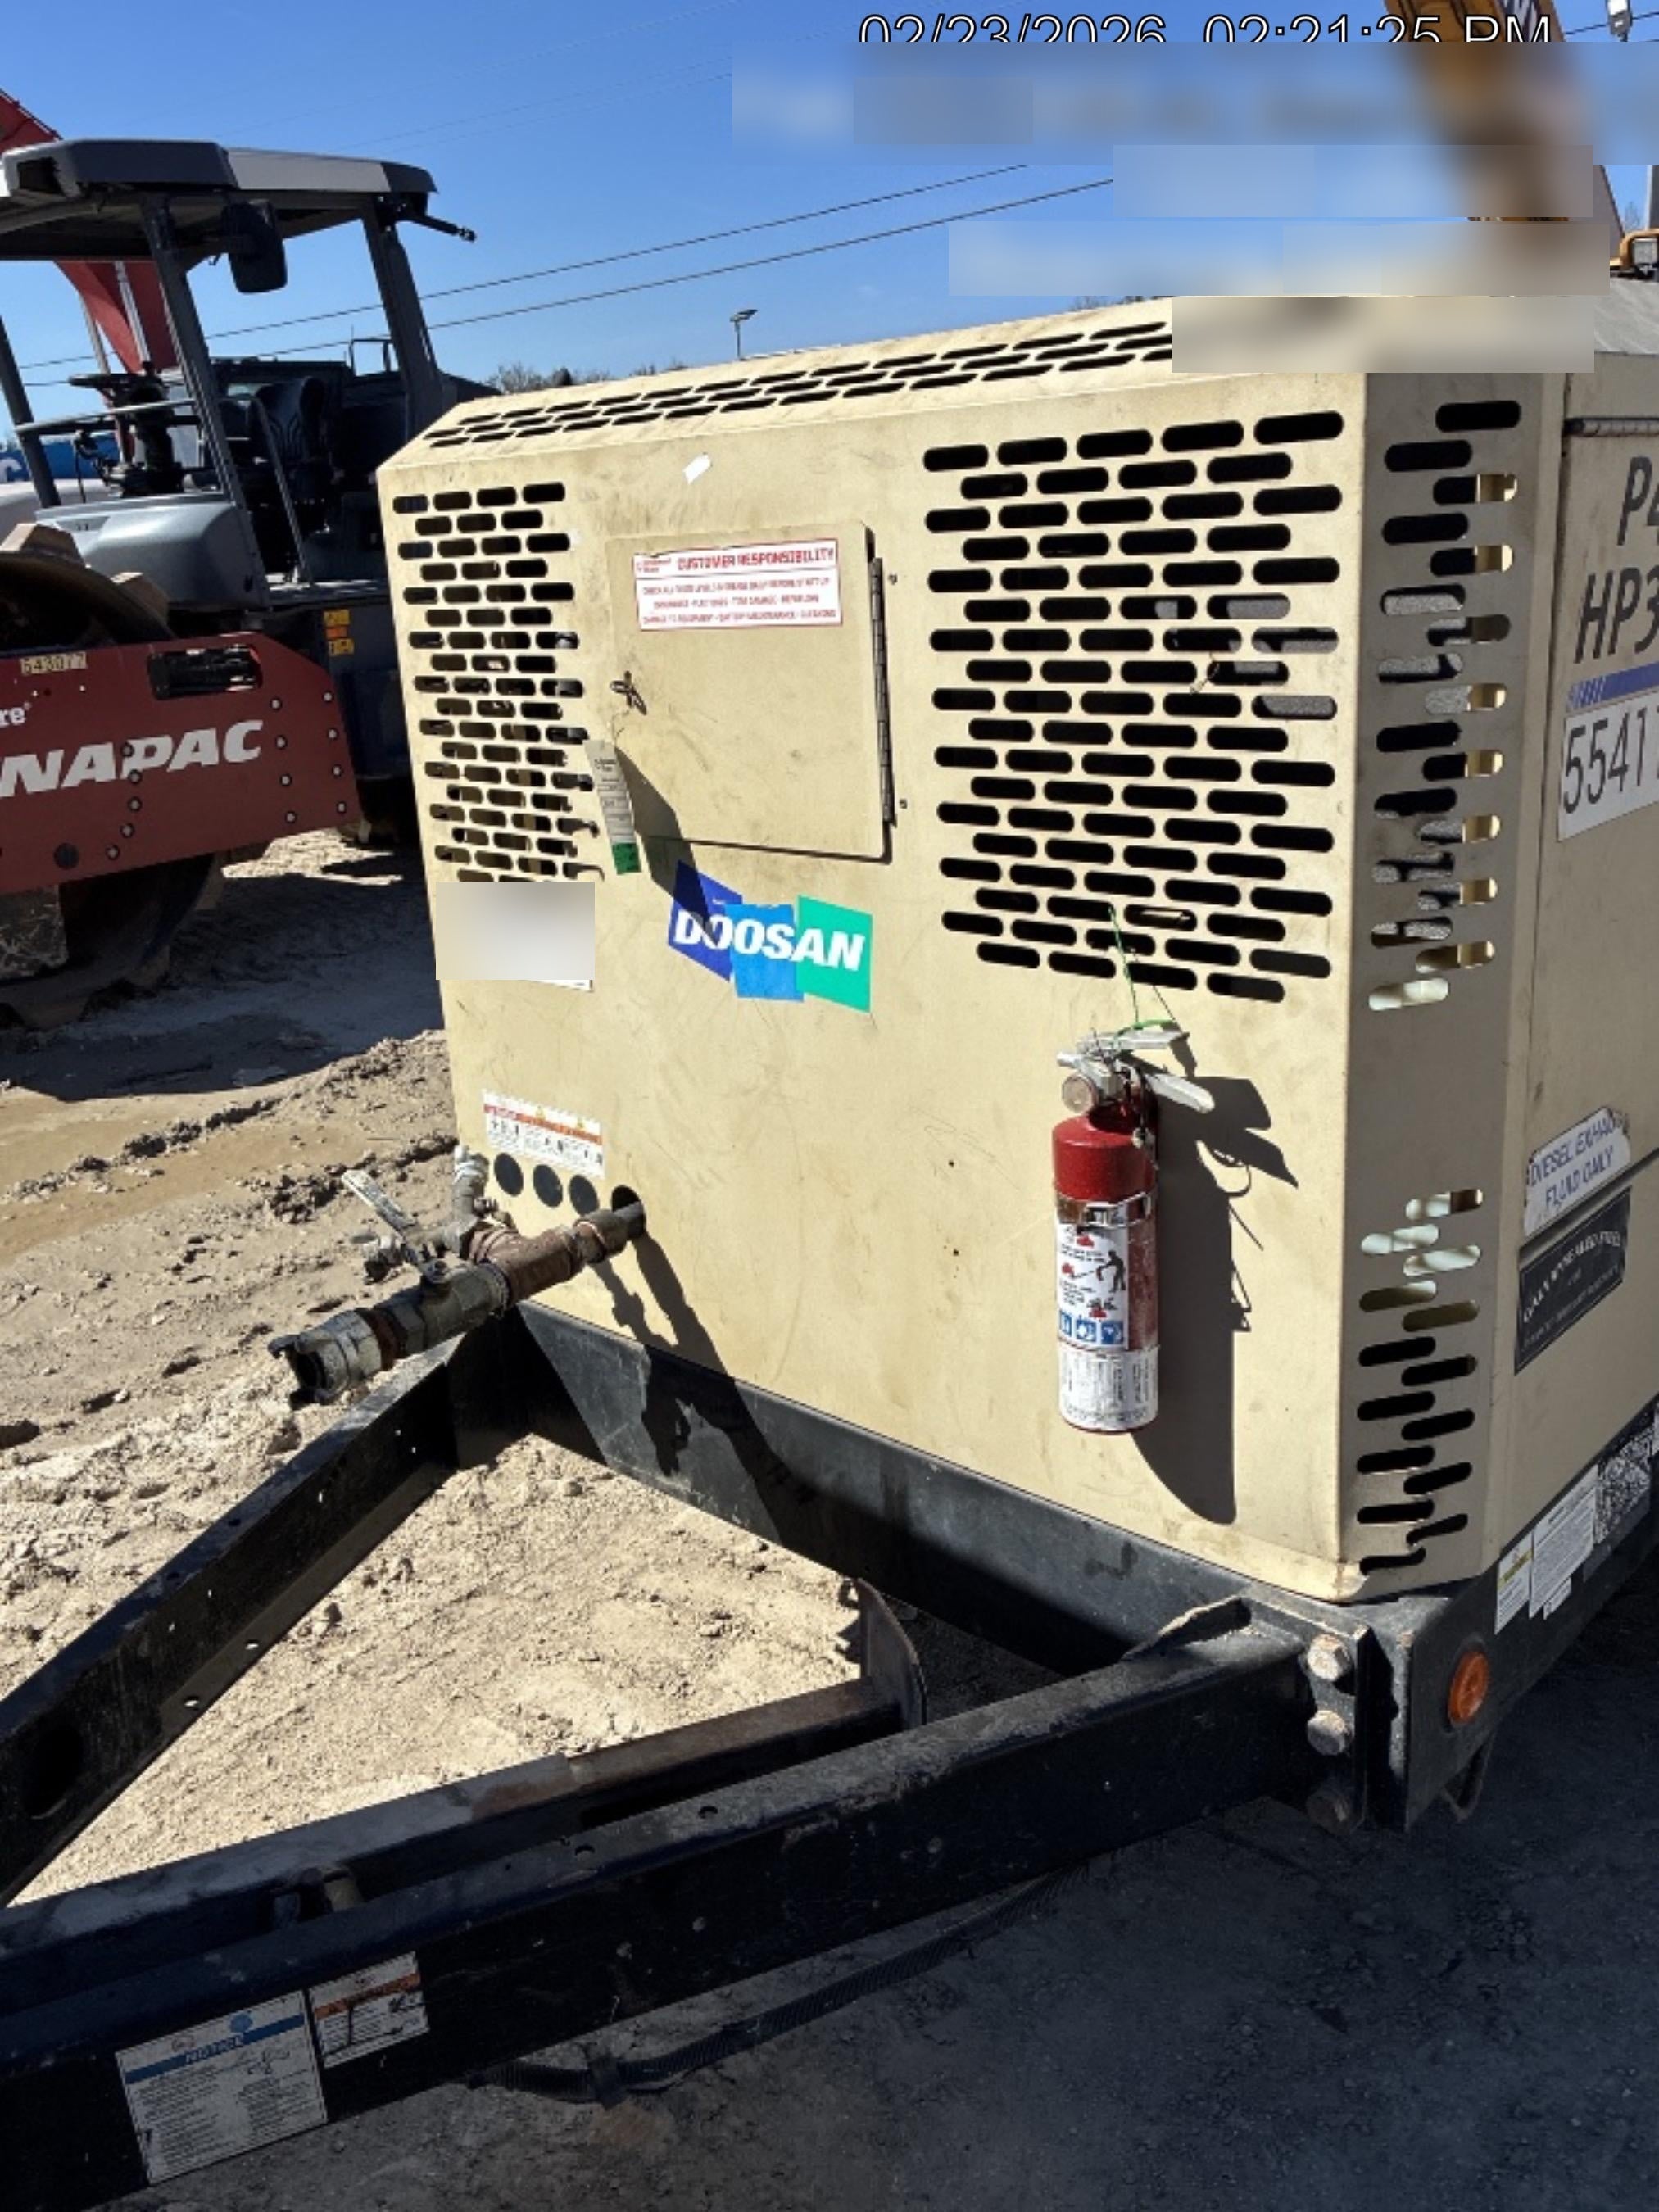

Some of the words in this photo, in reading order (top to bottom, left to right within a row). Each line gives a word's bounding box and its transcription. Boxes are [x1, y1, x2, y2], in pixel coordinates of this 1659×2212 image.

[678, 554, 736, 571] CUSTOMER
[737, 547, 834, 566] RESPONSIBILITY
[1563, 707, 1659, 814] 5541
[674, 909, 866, 972] DOOSAN
